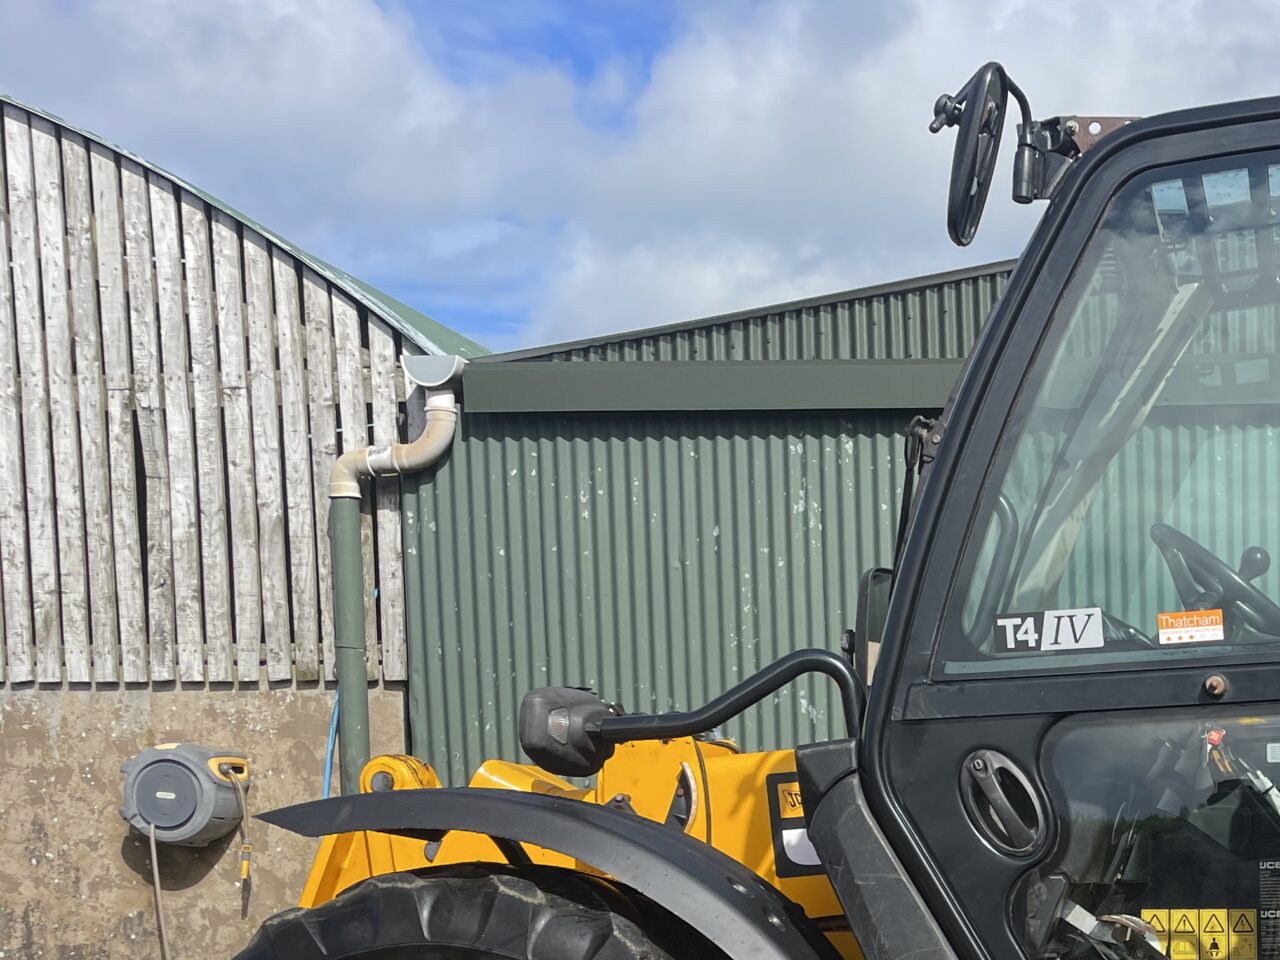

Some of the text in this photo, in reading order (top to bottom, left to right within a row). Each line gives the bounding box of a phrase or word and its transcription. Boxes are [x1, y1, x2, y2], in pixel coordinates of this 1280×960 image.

[1160, 615, 1220, 629] Thatcham
[997, 613, 1095, 649] T4 IV
[787, 792, 802, 808] JC
